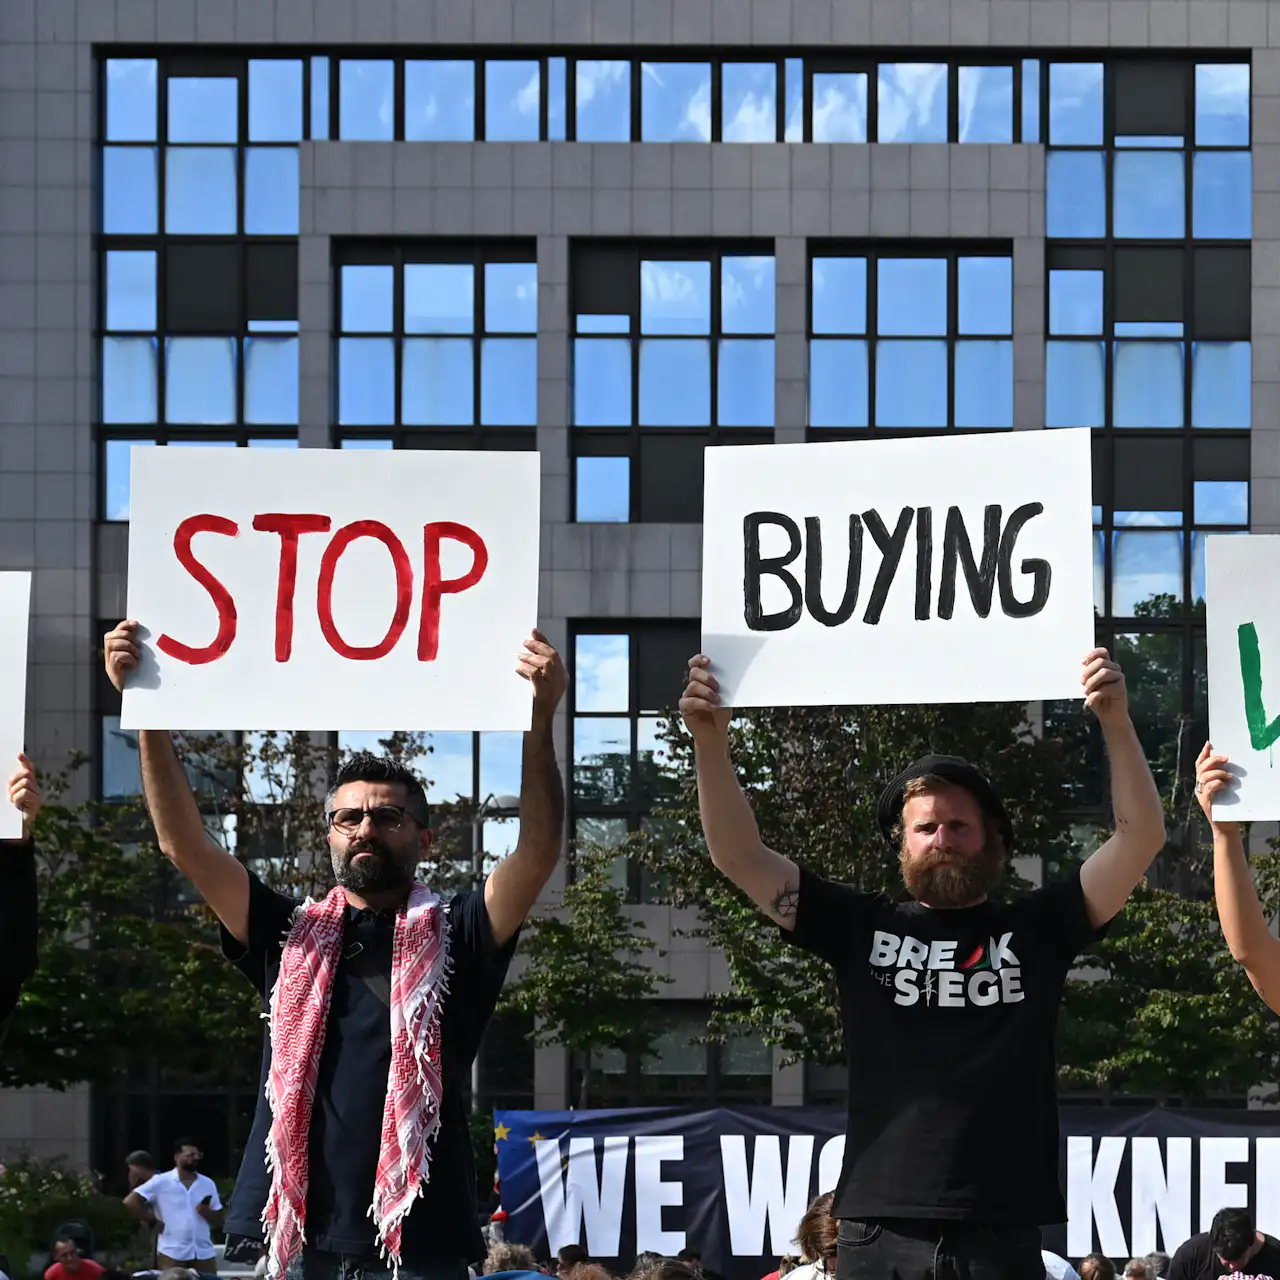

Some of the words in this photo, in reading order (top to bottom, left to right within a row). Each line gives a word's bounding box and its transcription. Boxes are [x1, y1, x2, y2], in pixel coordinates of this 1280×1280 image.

[157, 513, 489, 665] STOP
[744, 502, 1052, 632] BUYING
[894, 968, 1026, 1008] SIEGE
[535, 1135, 687, 1258] WE
